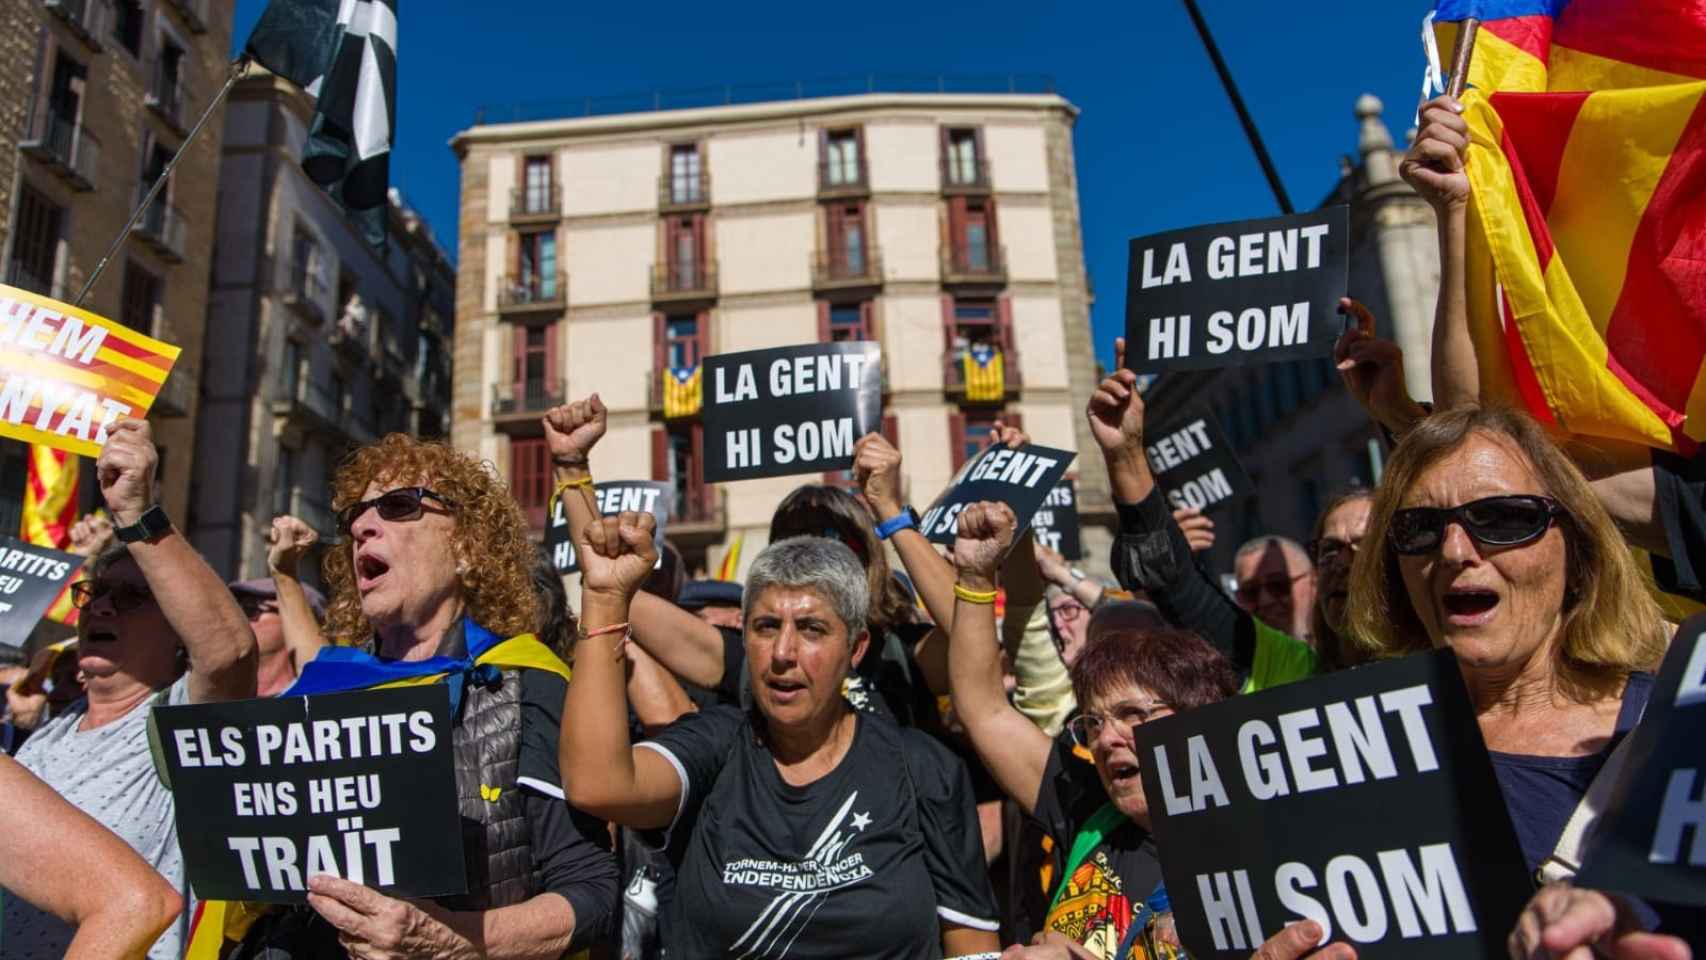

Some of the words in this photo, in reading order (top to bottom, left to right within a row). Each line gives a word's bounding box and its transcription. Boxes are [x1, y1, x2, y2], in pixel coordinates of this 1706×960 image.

[1141, 242, 1192, 289] LA
[1207, 224, 1329, 280] GENT
[1148, 315, 1191, 360] HI
[1206, 302, 1310, 354] SOM
[715, 363, 758, 404] LA
[769, 354, 865, 397] GENT
[726, 428, 761, 468] HI
[773, 418, 854, 464] SOM
[969, 450, 1057, 488] GENT
[1146, 419, 1212, 474] GENT
[173, 727, 246, 767] ELS
[256, 711, 436, 765] PARTITS
[1153, 735, 1231, 816] LA
[1238, 684, 1439, 800] GENT
[233, 782, 297, 816] ENS
[308, 774, 382, 814] HEU
[228, 816, 400, 891] TRAÏT
[1196, 869, 1265, 951] HI
[1275, 843, 1477, 947] SOM
